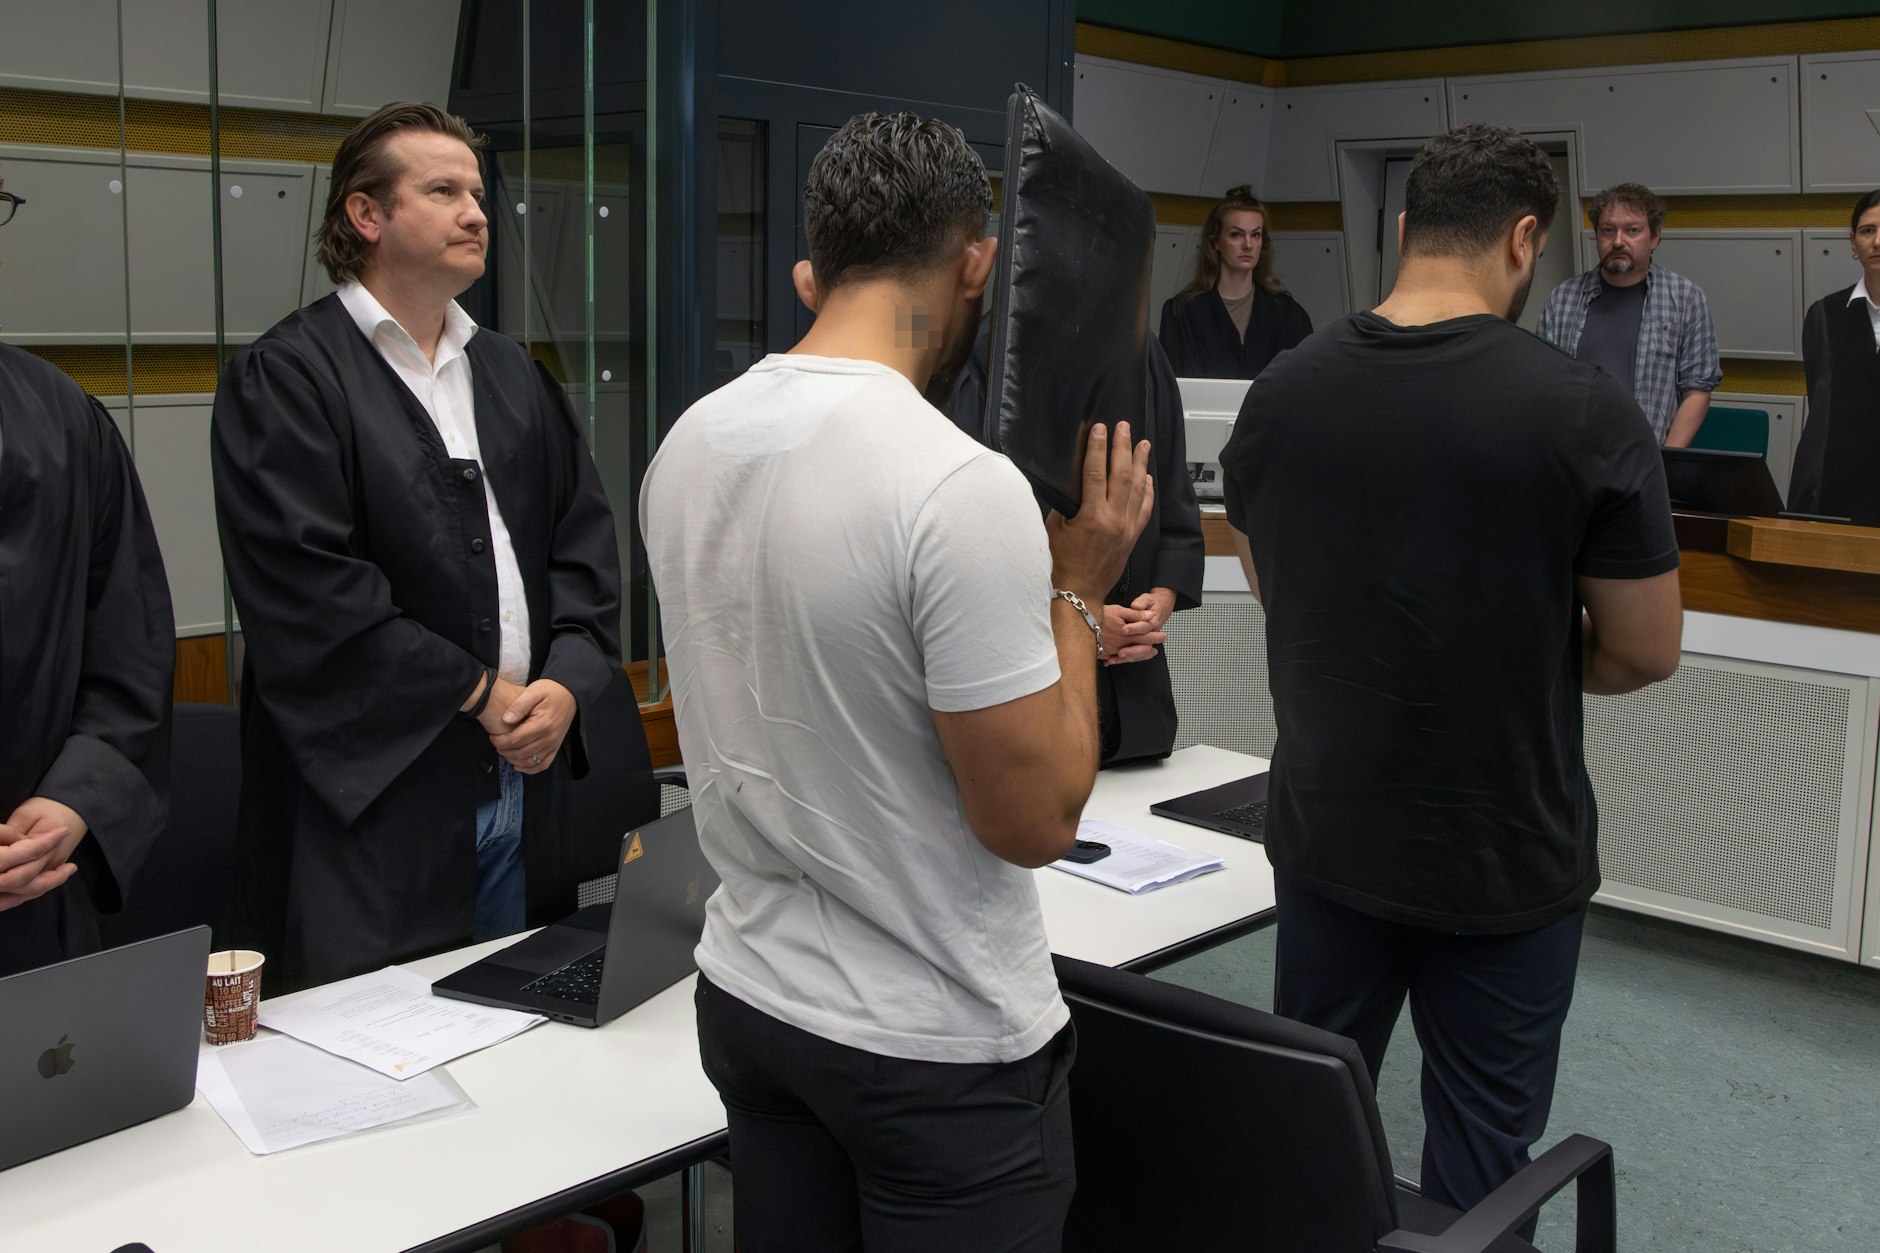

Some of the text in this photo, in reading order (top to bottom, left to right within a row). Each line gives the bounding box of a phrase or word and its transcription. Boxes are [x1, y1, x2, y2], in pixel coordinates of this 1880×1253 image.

[212, 978, 222, 986] AU
[224, 976, 242, 986] LAIT
[219, 987, 229, 996] TO
[231, 985, 242, 994] GO
[214, 998, 242, 1010] KAFFEE
[205, 1006, 216, 1027] CREMA
[218, 1033, 226, 1043] TO
[227, 1032, 237, 1042] GO
